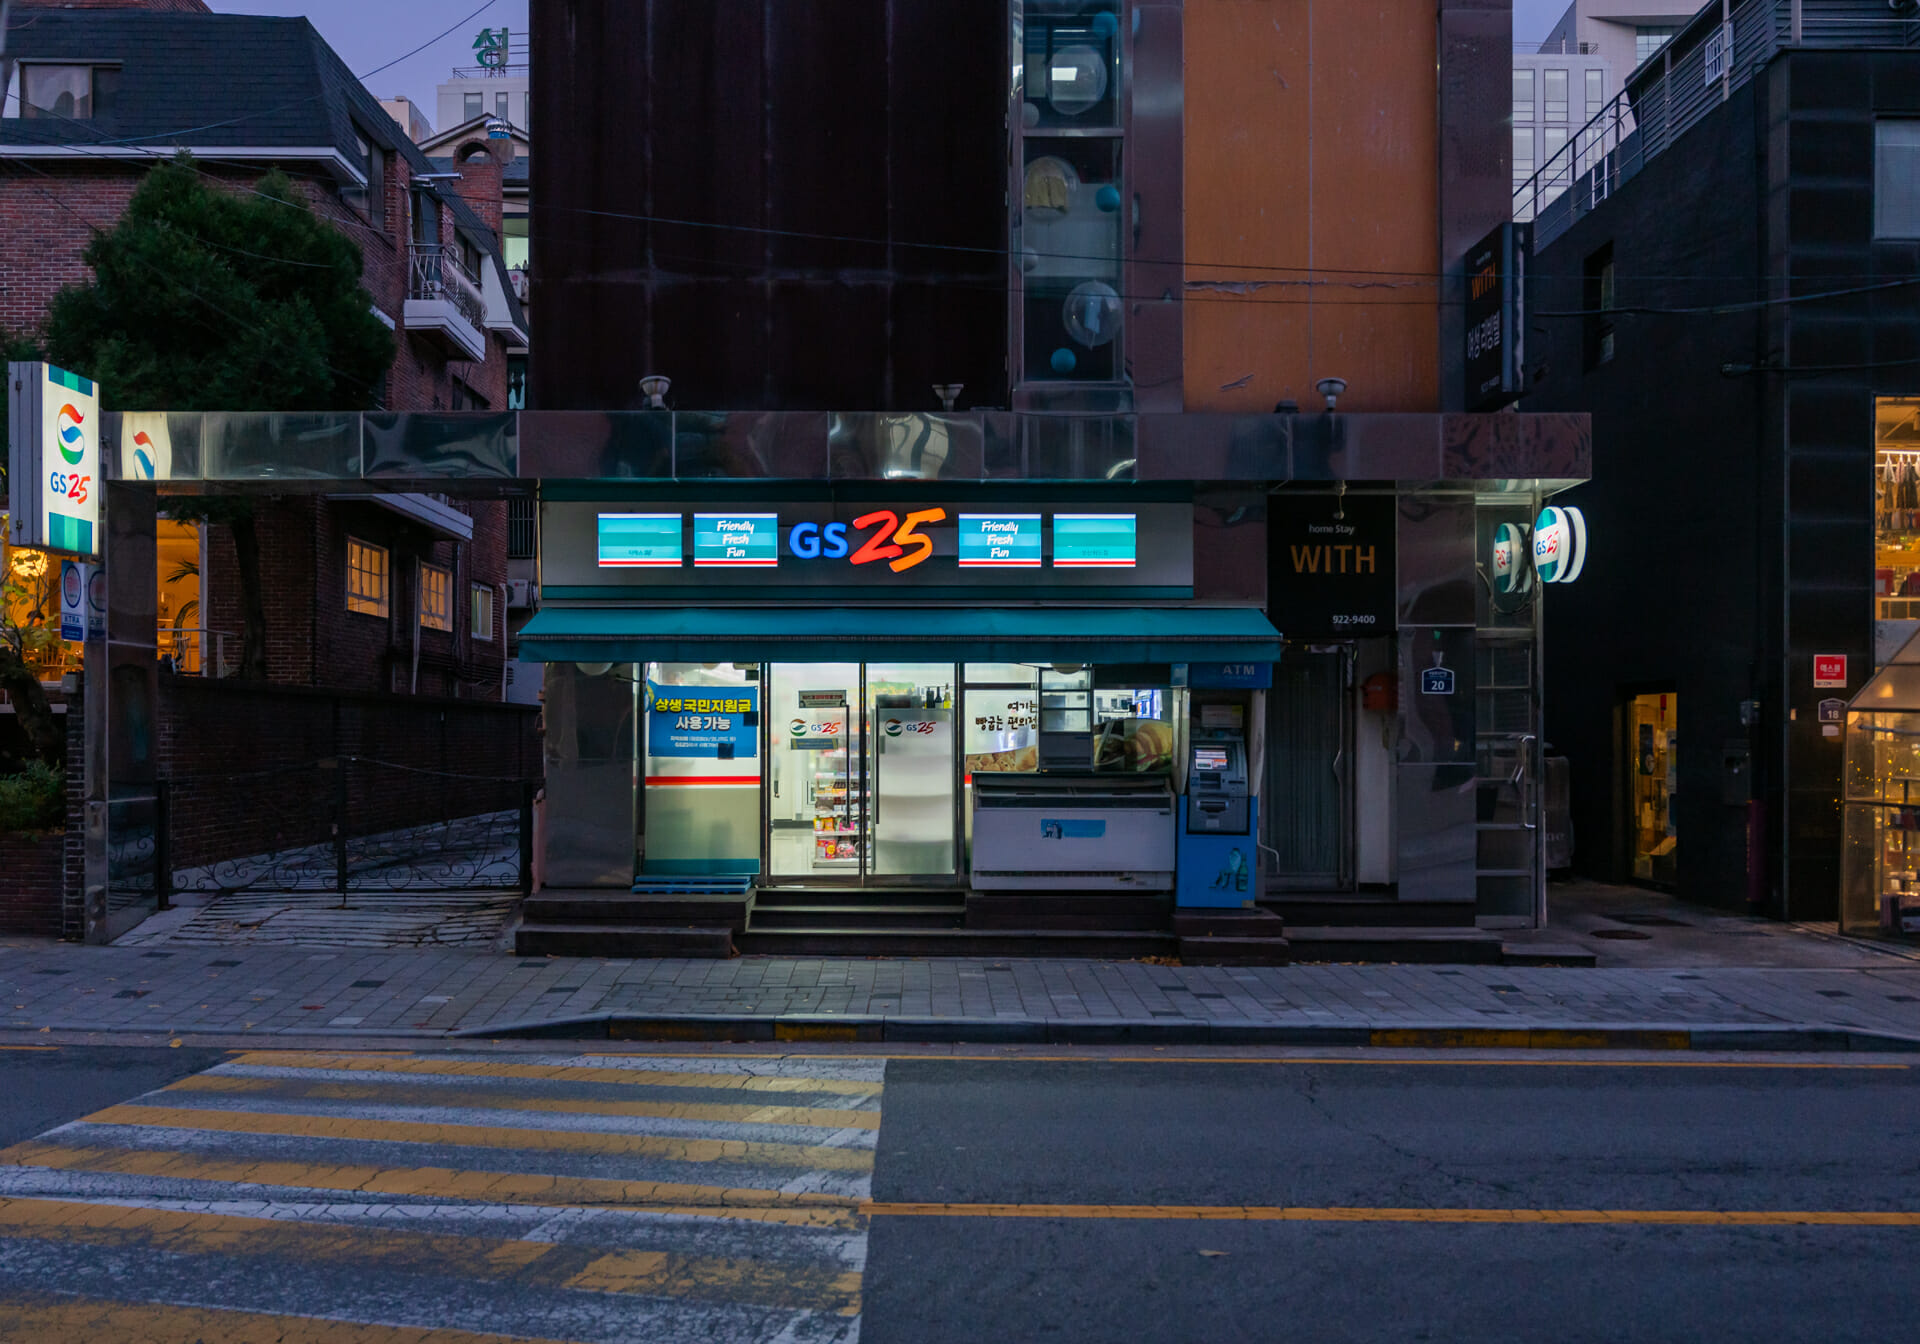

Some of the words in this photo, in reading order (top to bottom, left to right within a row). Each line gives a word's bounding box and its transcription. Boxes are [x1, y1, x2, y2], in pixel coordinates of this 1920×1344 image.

[1471, 261, 1497, 301] WITH
[716, 520, 755, 534] Friendly
[981, 521, 1019, 534] Friendly
[1308, 524, 1334, 534] home
[1335, 524, 1355, 536] Stay
[722, 533, 749, 545] Fresh
[986, 534, 1014, 546] Fresh
[726, 547, 746, 558] Fun
[990, 547, 1010, 558] Fun
[1290, 545, 1375, 573] WITH
[1332, 615, 1376, 625] 922-9400
[1223, 664, 1255, 675] ATM
[1431, 680, 1445, 690] 20
[655, 698, 682, 713] 상생
[683, 698, 752, 713] 국민지원금
[1007, 700, 1038, 713] 여기는
[1827, 710, 1839, 719] 18
[675, 716, 703, 730] 사용
[703, 716, 731, 730] 가능
[975, 715, 1003, 731] 빵굽는
[1007, 715, 1038, 730] 편의점
